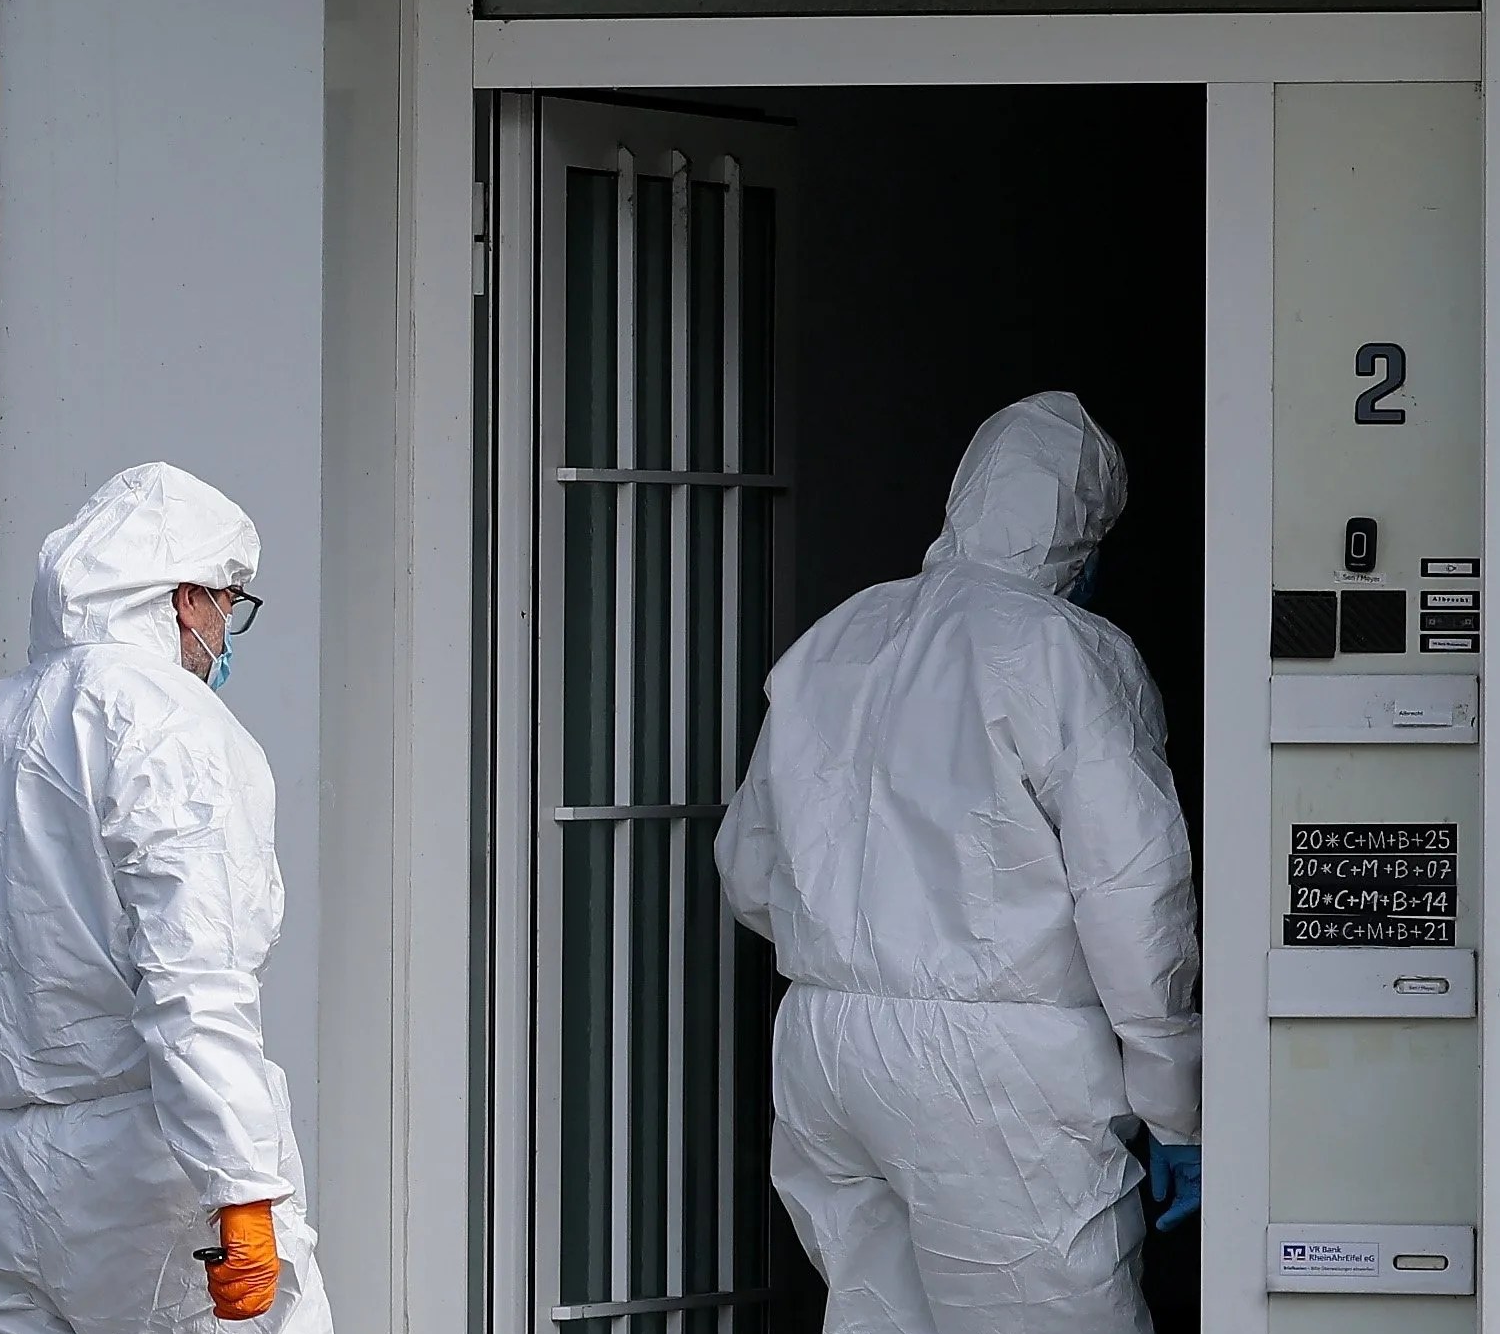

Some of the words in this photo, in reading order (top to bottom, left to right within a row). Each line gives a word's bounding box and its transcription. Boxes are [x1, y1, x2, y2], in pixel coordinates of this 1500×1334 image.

[1355, 342, 1407, 425] 2
[1309, 1245, 1321, 1253] VR
[1322, 1245, 1342, 1254] Bank
[1309, 1254, 1362, 1263] RheinAhrEifel
